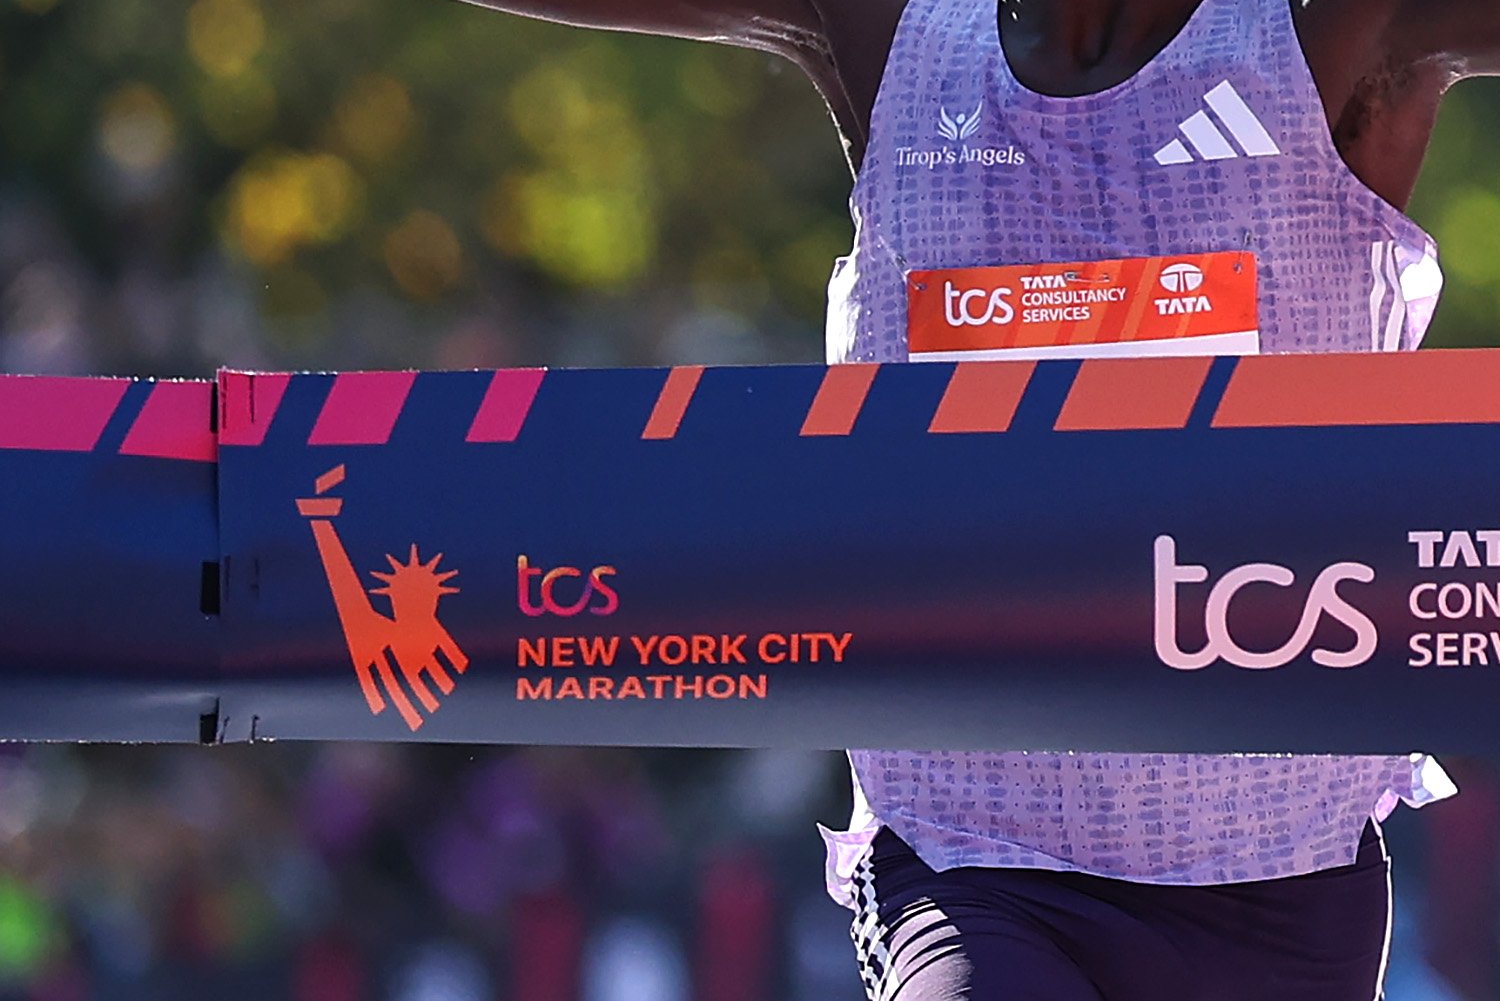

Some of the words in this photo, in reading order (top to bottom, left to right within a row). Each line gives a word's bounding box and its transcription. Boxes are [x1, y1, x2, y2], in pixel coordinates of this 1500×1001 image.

[896, 145, 956, 170] Tirop's
[958, 144, 1025, 166] Angels
[1020, 274, 1067, 290] TATA
[944, 281, 1014, 327] tcs
[1021, 287, 1126, 307] CONSULTANCY
[1154, 295, 1212, 316] TATA
[1022, 306, 1090, 323] SERVICES
[516, 554, 619, 617] tcs
[1153, 534, 1378, 670] tcs
[516, 636, 620, 667] NEW
[630, 634, 748, 664] YORK
[757, 632, 853, 662] CITY
[516, 674, 768, 700] MARATHON
